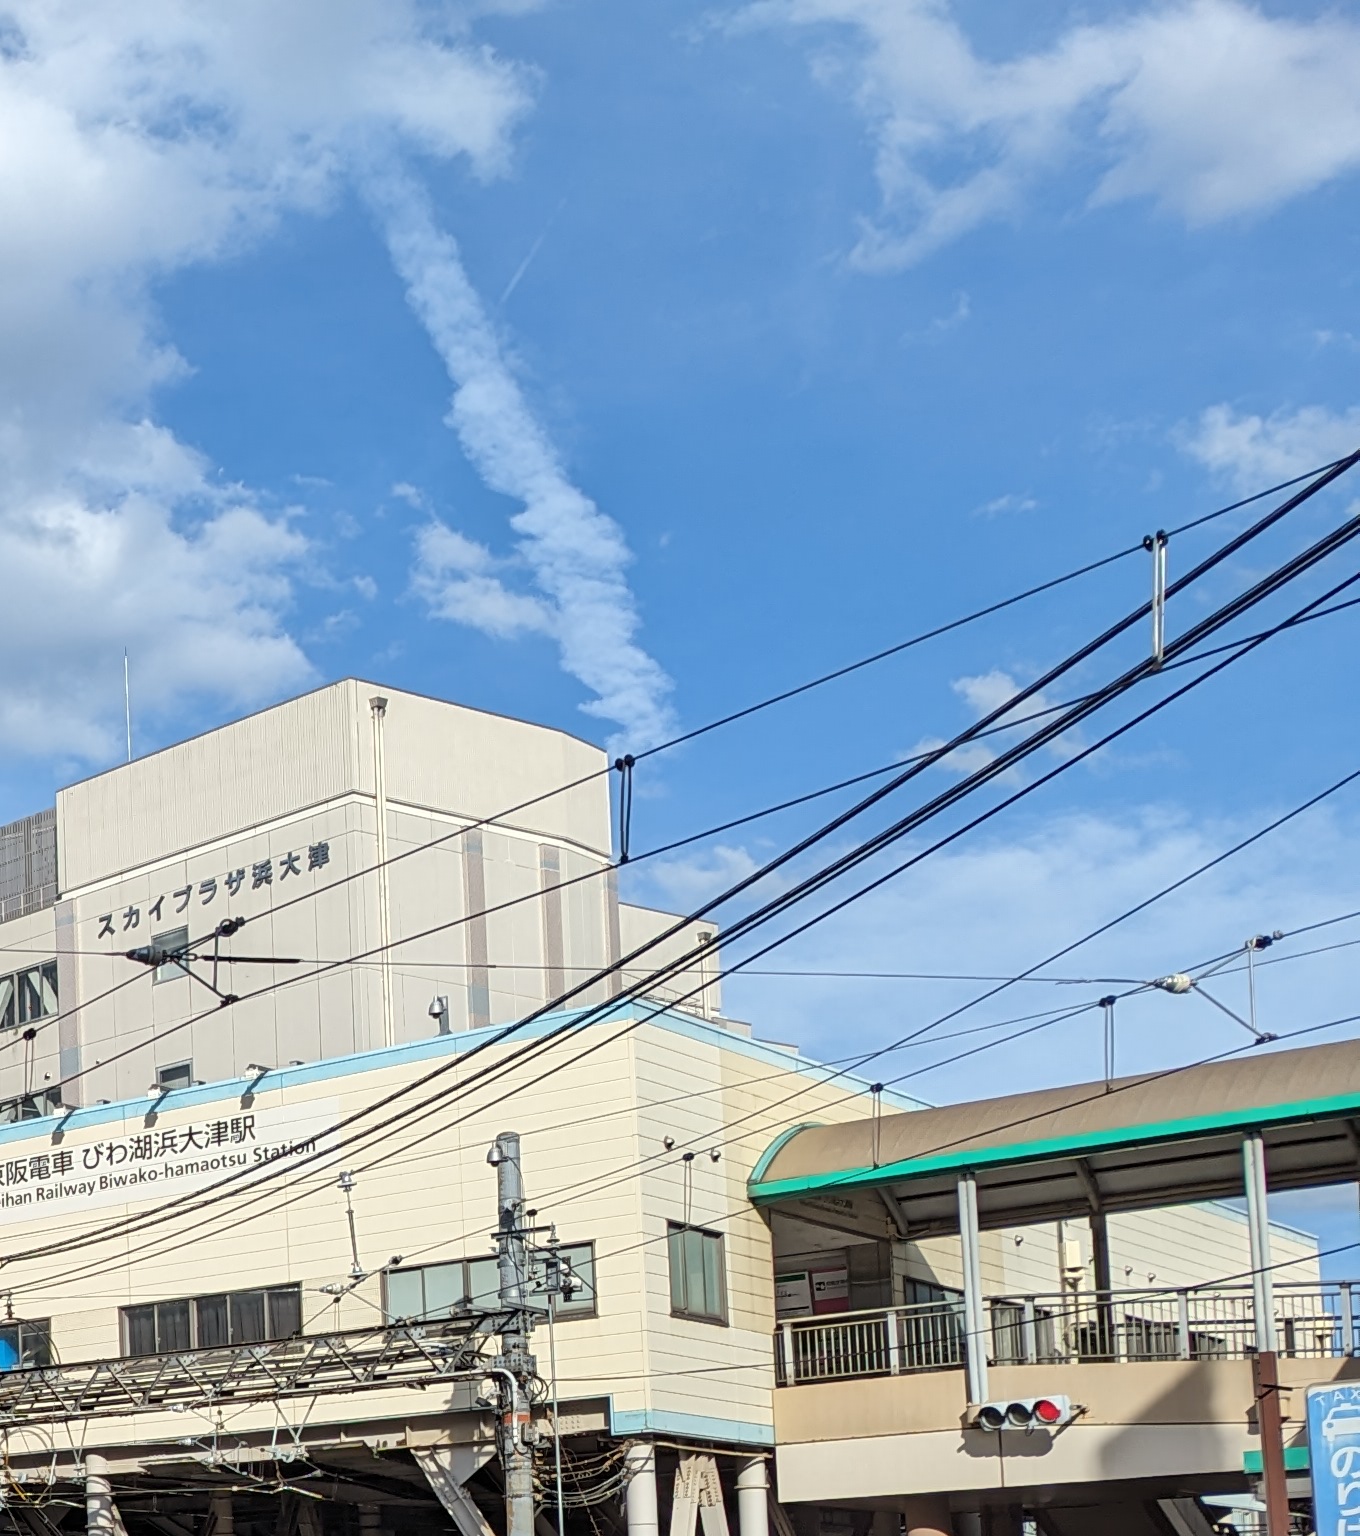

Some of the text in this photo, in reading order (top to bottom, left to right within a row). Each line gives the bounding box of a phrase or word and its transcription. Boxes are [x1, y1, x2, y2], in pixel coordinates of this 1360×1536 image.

[98, 841, 330, 939] スカイプラザ浜大津
[36, 1181, 96, 1202] Railway
[100, 1153, 247, 1190] Biwako-hamaotsu
[254, 1140, 316, 1162] Station
[83, 1115, 256, 1170] びわ湖浜大津駅
